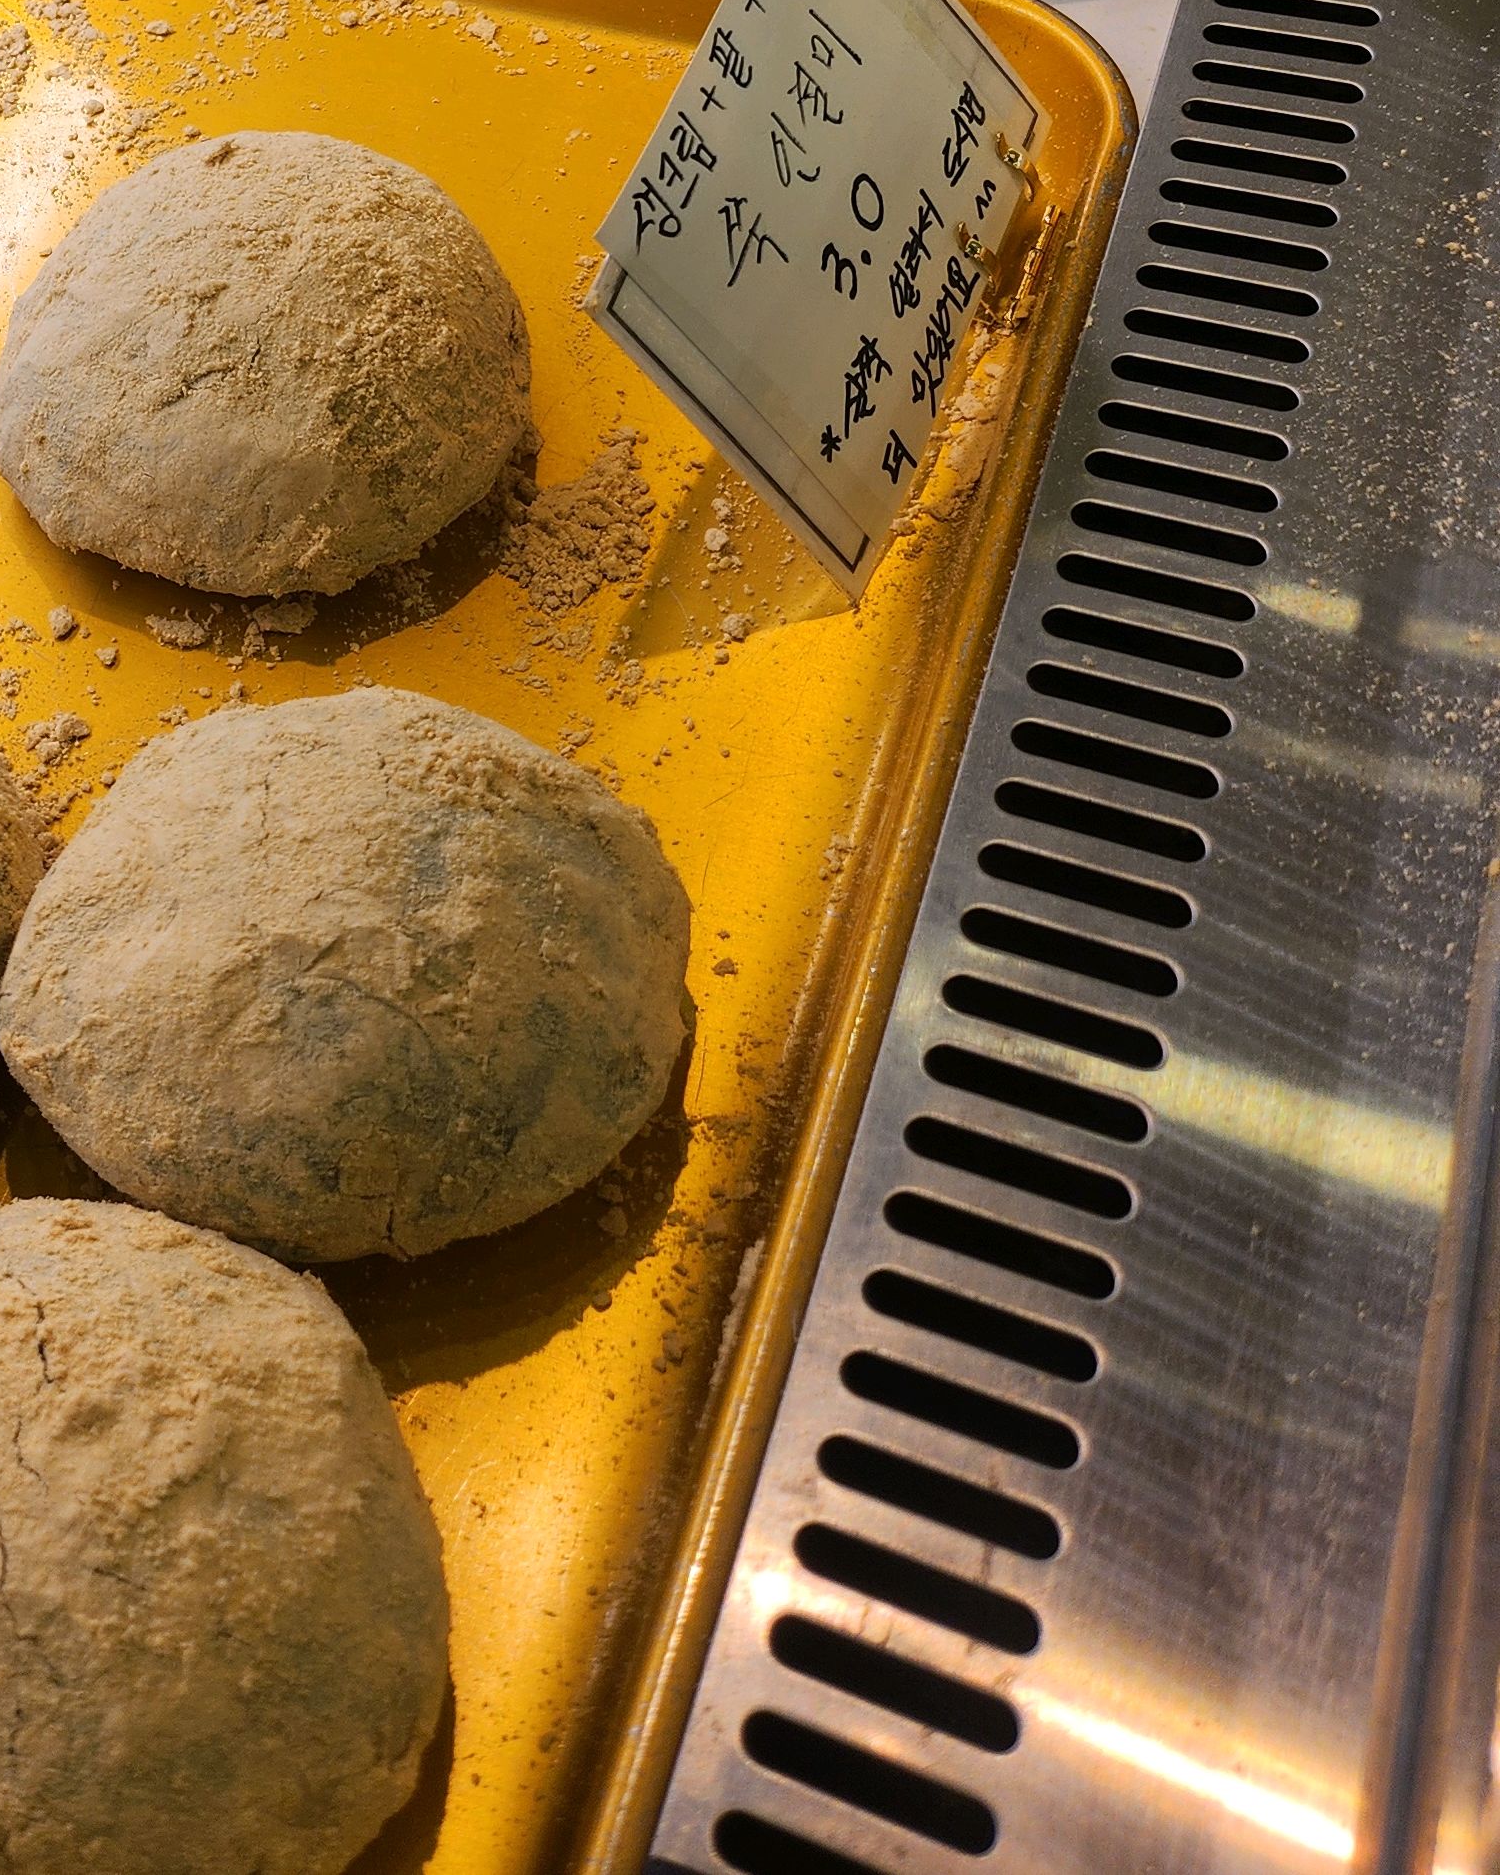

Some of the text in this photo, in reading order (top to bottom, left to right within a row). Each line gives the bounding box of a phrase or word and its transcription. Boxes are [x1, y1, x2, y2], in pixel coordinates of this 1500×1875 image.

[717, 196, 789, 288] 쑥
[820, 172, 885, 300] 3.0
[888, 188, 945, 319] 얼려서
[941, 80, 986, 187] 드시면
[882, 428, 918, 485] 더
